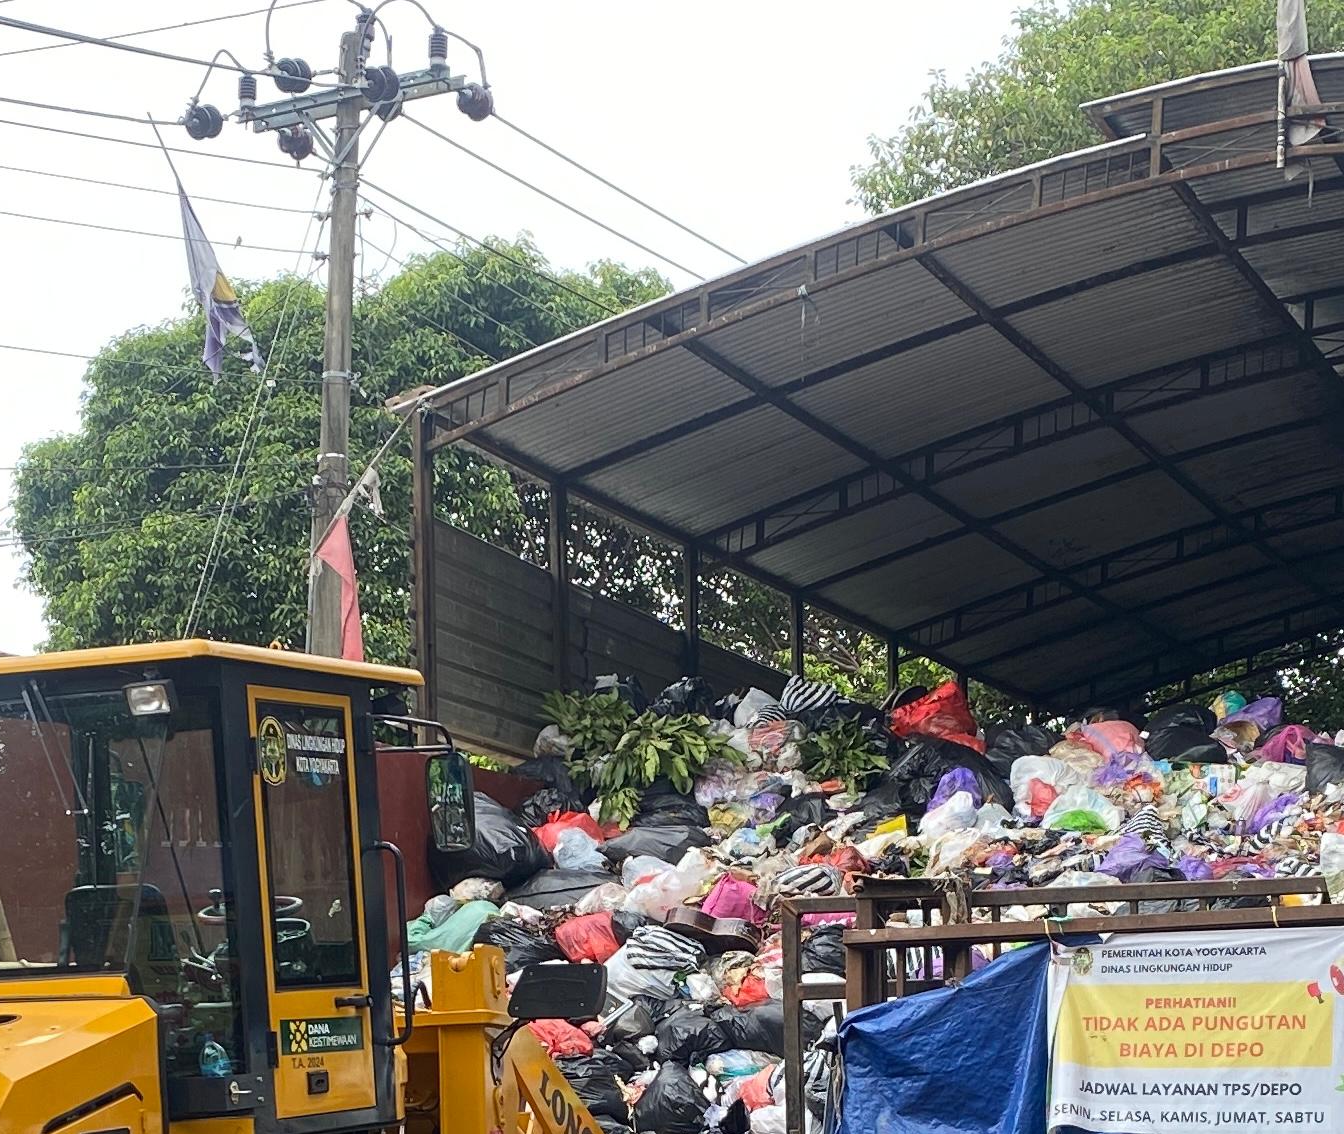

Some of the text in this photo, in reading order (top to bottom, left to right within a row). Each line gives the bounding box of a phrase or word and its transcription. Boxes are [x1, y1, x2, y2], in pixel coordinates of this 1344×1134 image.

[1102, 946, 1267, 959] PEMERINTAH KOTA YOGYAKARTA
[1101, 963, 1233, 974] DINAS LINGKUNGAN HIDUP
[308, 1023, 331, 1035] DANA
[1082, 1014, 1307, 1032] TIDAK ADA PUNGUTAN
[1119, 1042, 1265, 1059] BIAYA DI DEPO
[1079, 1080, 1302, 1098] JADWAL LAYANAN TPS/DEPO
[1099, 1110, 1155, 1124] SELASA,
[1160, 1111, 1212, 1125] KAMIS,
[1214, 1111, 1270, 1126] JUMAT,
[1274, 1111, 1325, 1124] SABTU
